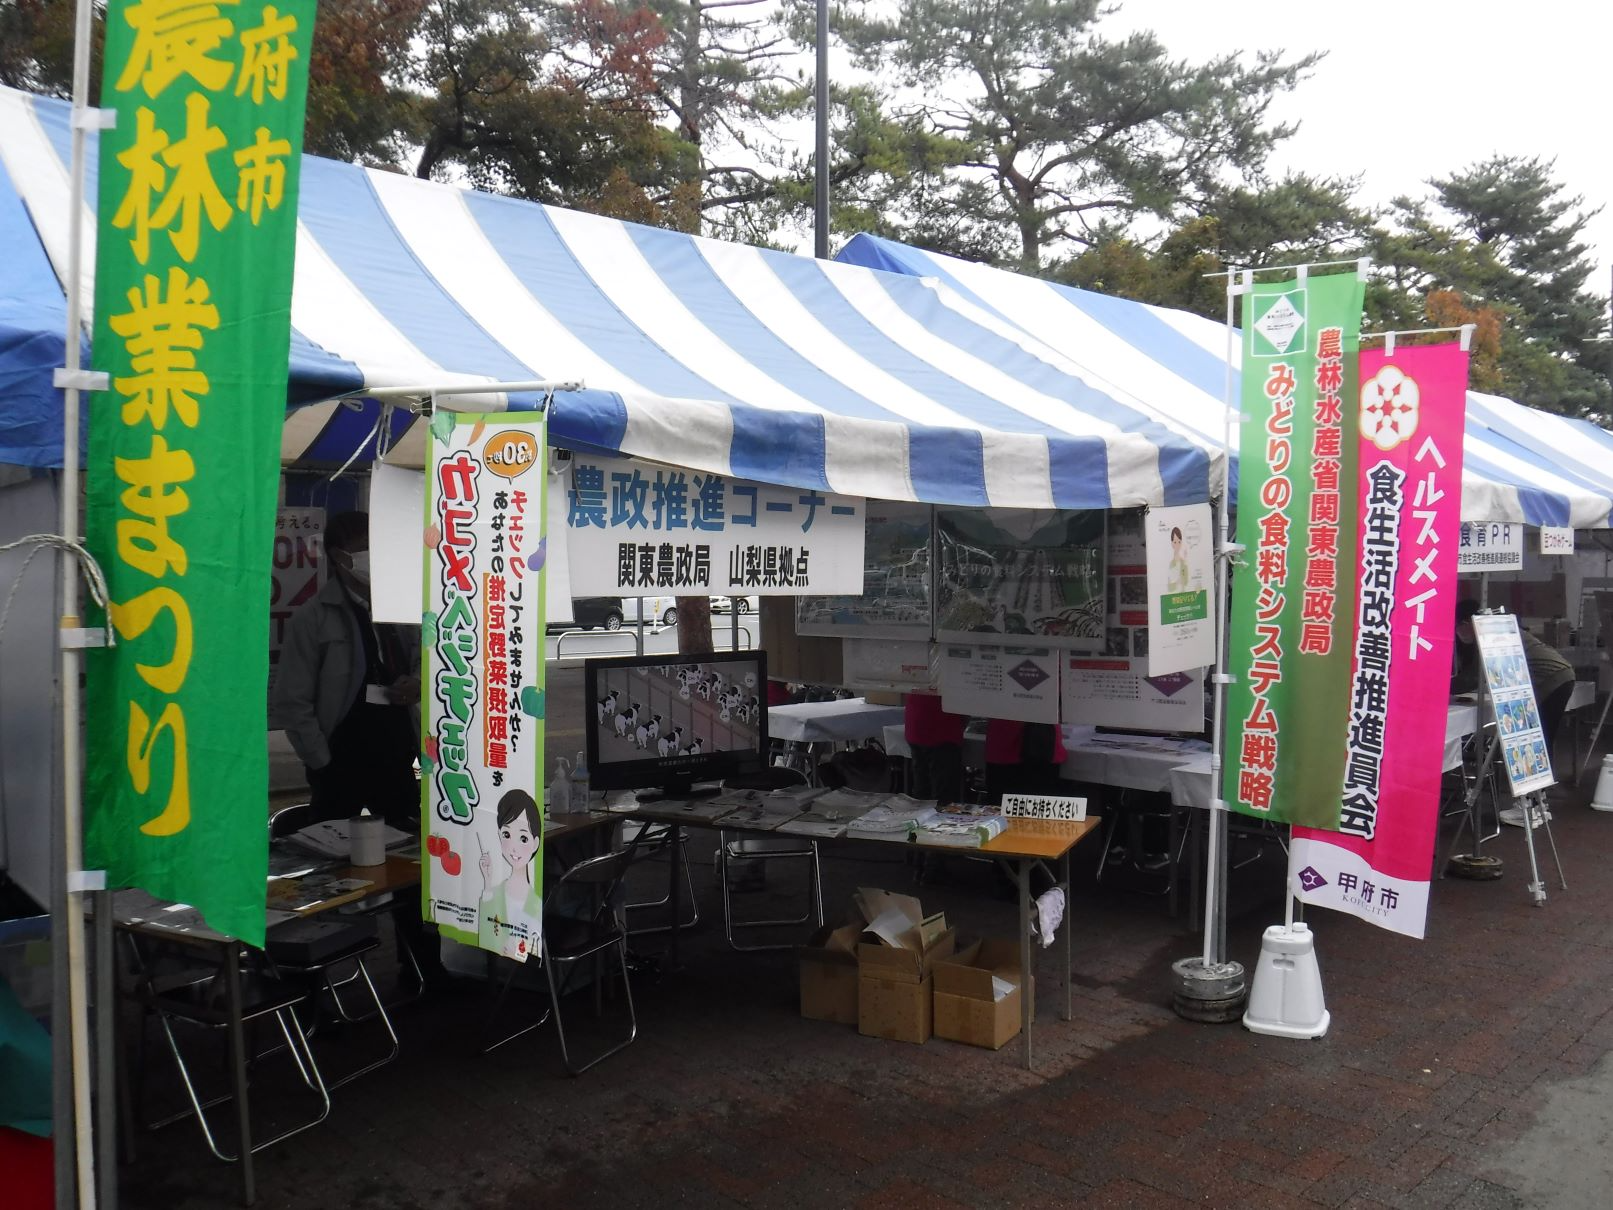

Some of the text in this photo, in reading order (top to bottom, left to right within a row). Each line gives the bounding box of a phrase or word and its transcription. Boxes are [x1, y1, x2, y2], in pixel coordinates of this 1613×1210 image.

[567, 464, 855, 533] 農政推進コーナー
[1298, 328, 1343, 655] 農林水産省関東農政局
[1404, 435, 1447, 661] ヘルスメイト
[617, 543, 810, 588] 関東農政局 山梨県拠点
[1238, 364, 1297, 812] みどりの食料システム戦略
[1340, 462, 1404, 839] 食生活改善推進員会
[1004, 797, 1079, 819] ご自由にお持ちください
[1337, 871, 1400, 910] 甲府市
